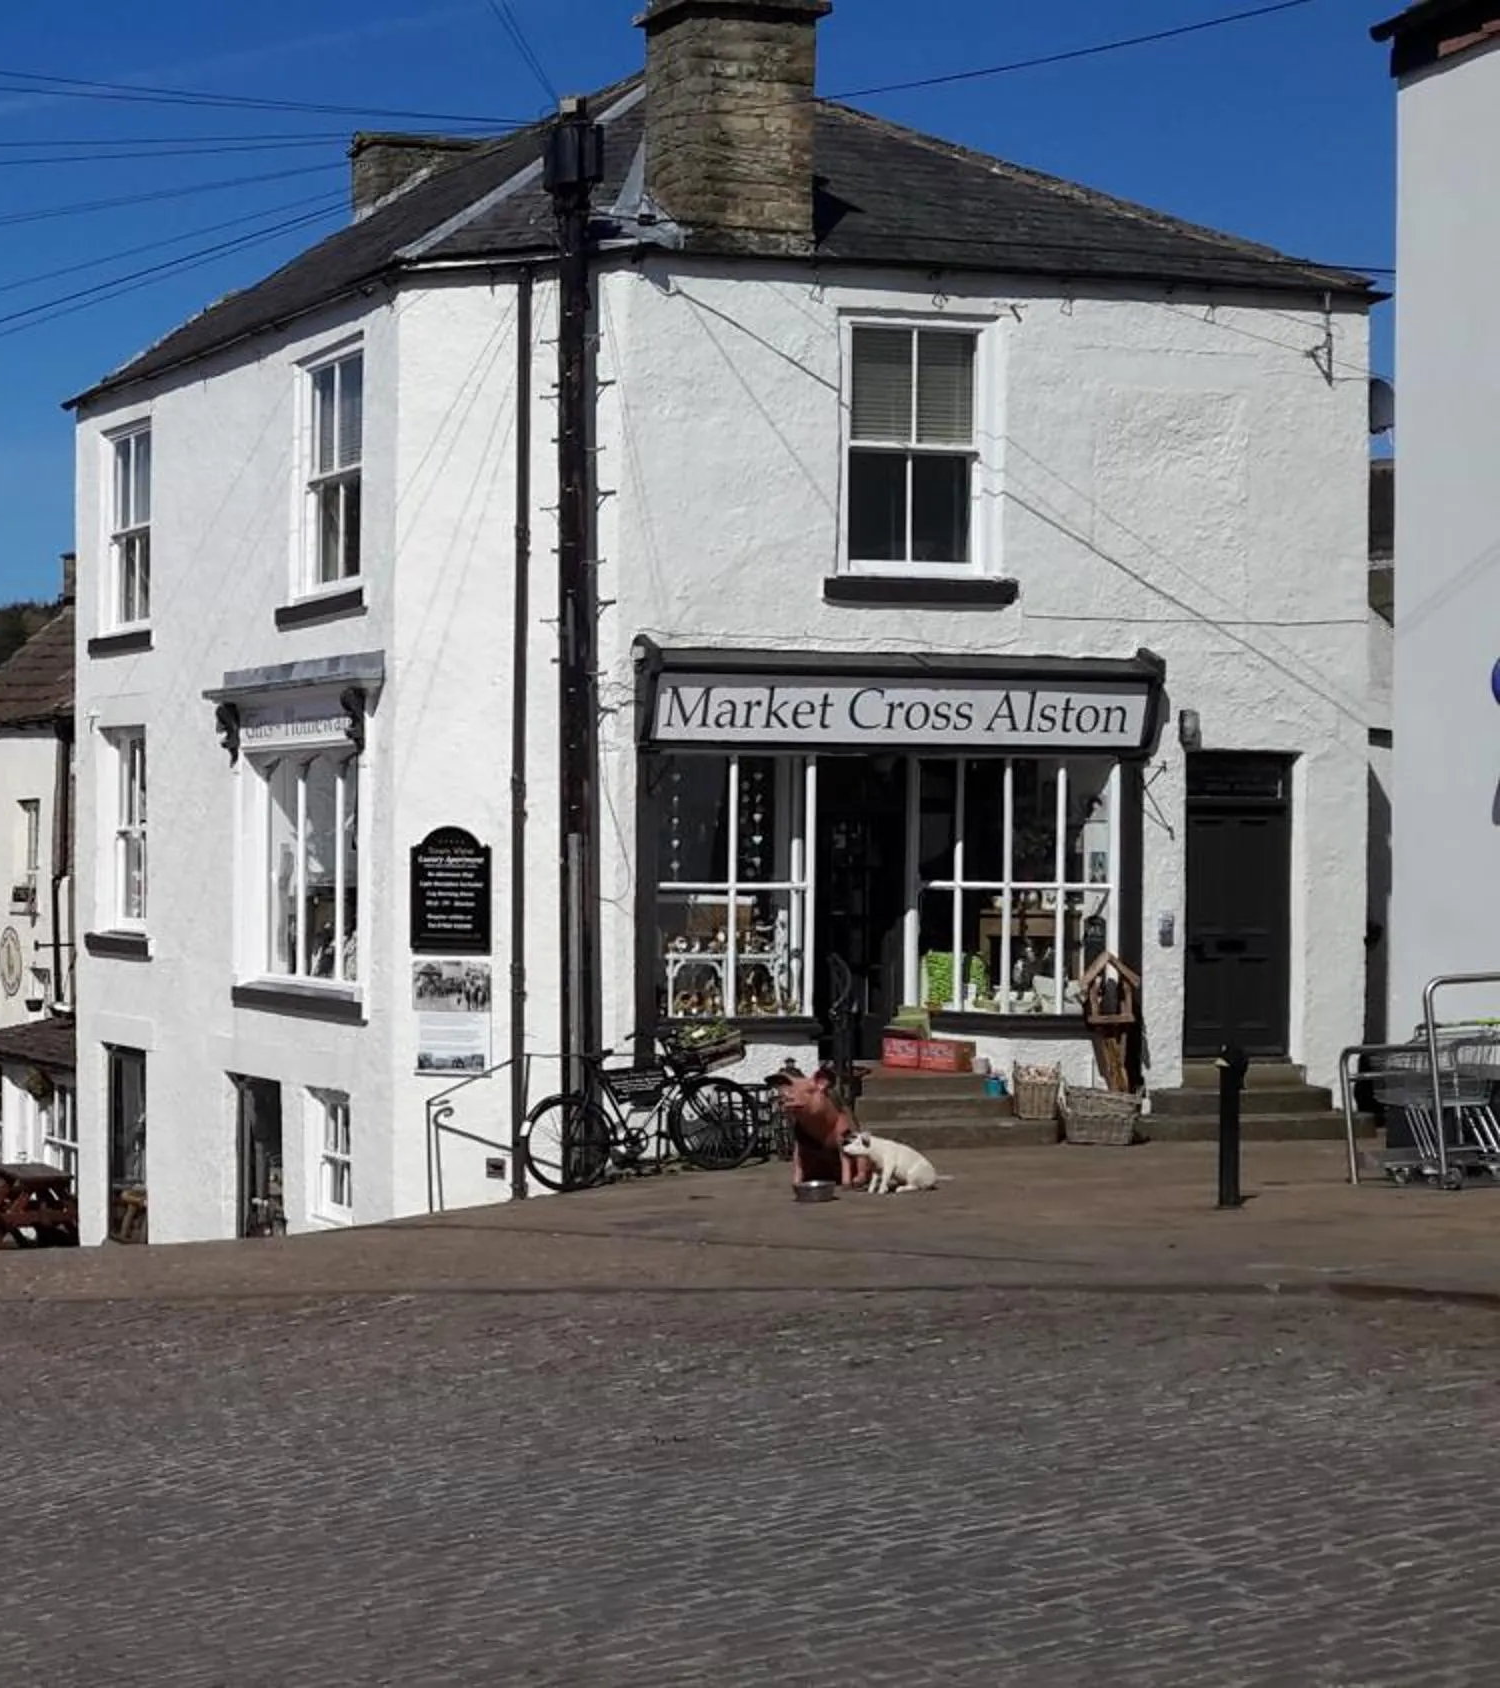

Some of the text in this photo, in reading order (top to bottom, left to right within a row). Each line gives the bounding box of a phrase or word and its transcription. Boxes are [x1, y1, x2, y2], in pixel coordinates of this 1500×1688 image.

[662, 685, 1129, 734] Market Cross Alston
